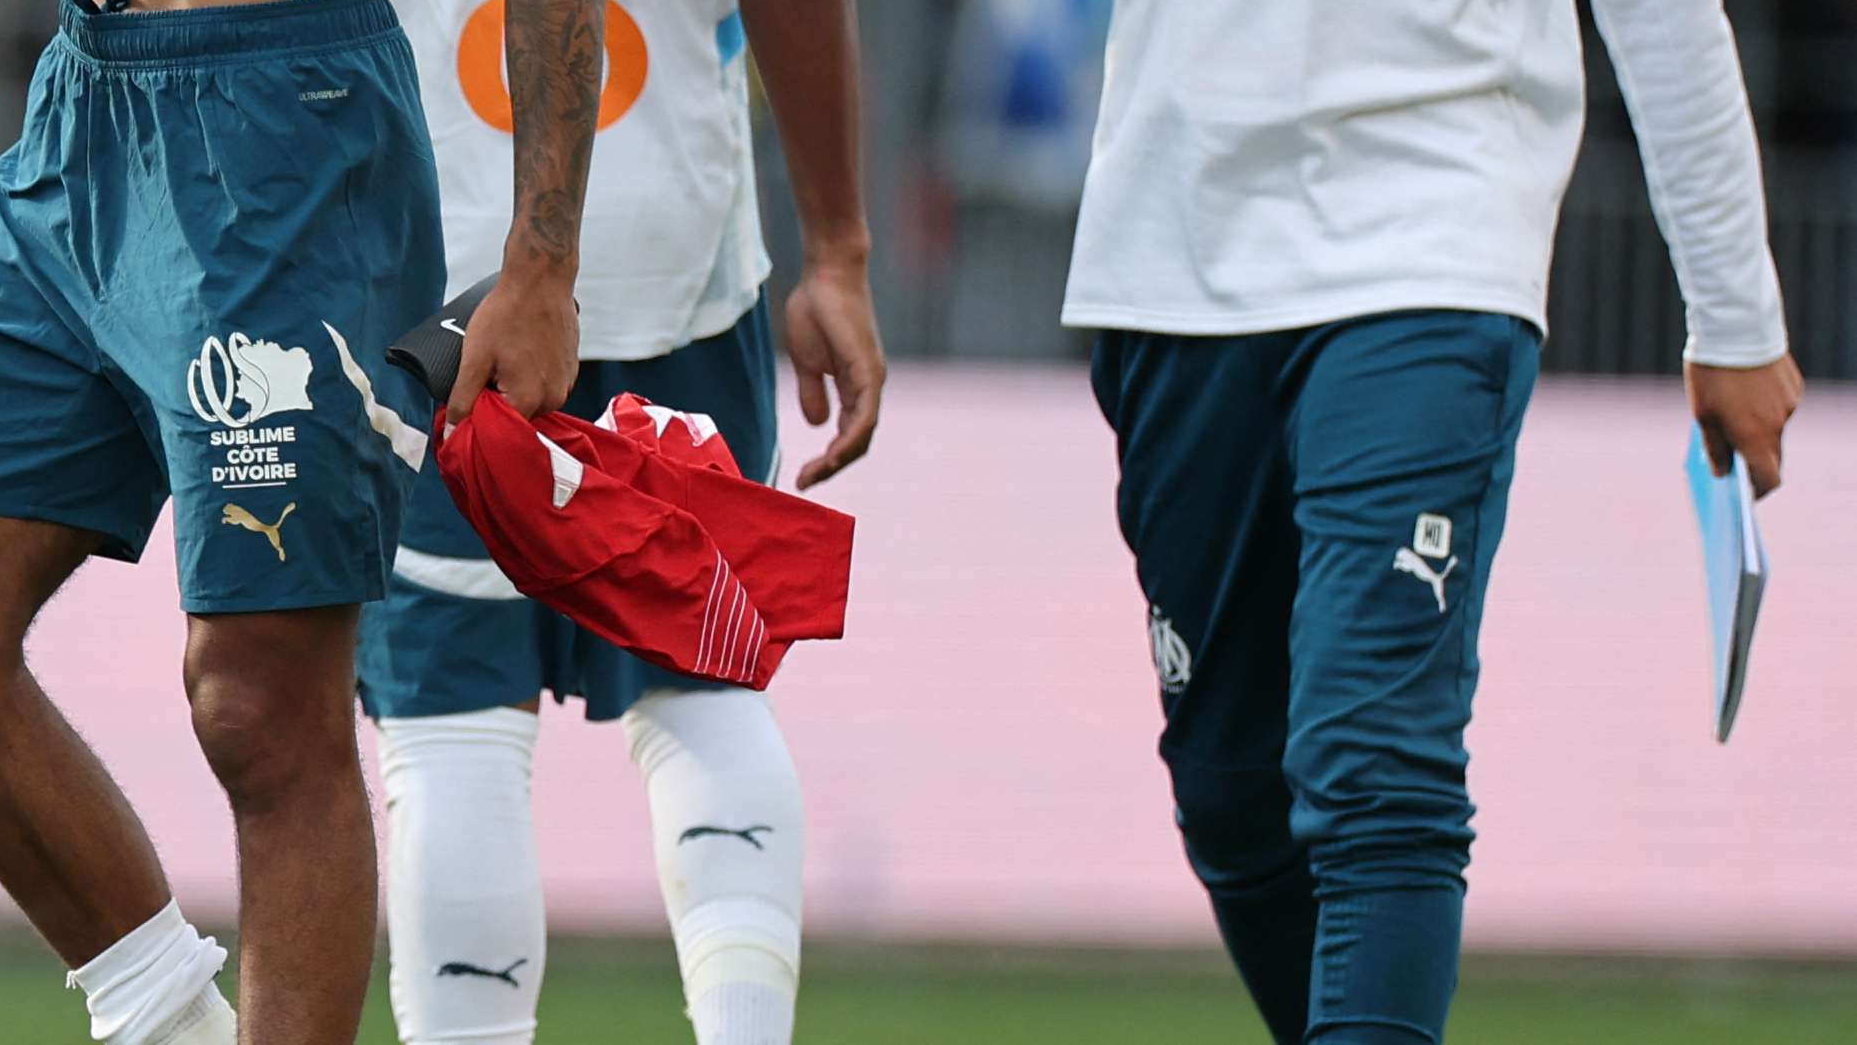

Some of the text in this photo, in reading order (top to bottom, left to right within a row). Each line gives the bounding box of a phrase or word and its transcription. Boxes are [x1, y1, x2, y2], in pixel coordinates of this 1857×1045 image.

[210, 426, 296, 446] SUBLIME
[226, 444, 280, 465] CÔTE
[211, 462, 298, 483] D'IVOIRE
